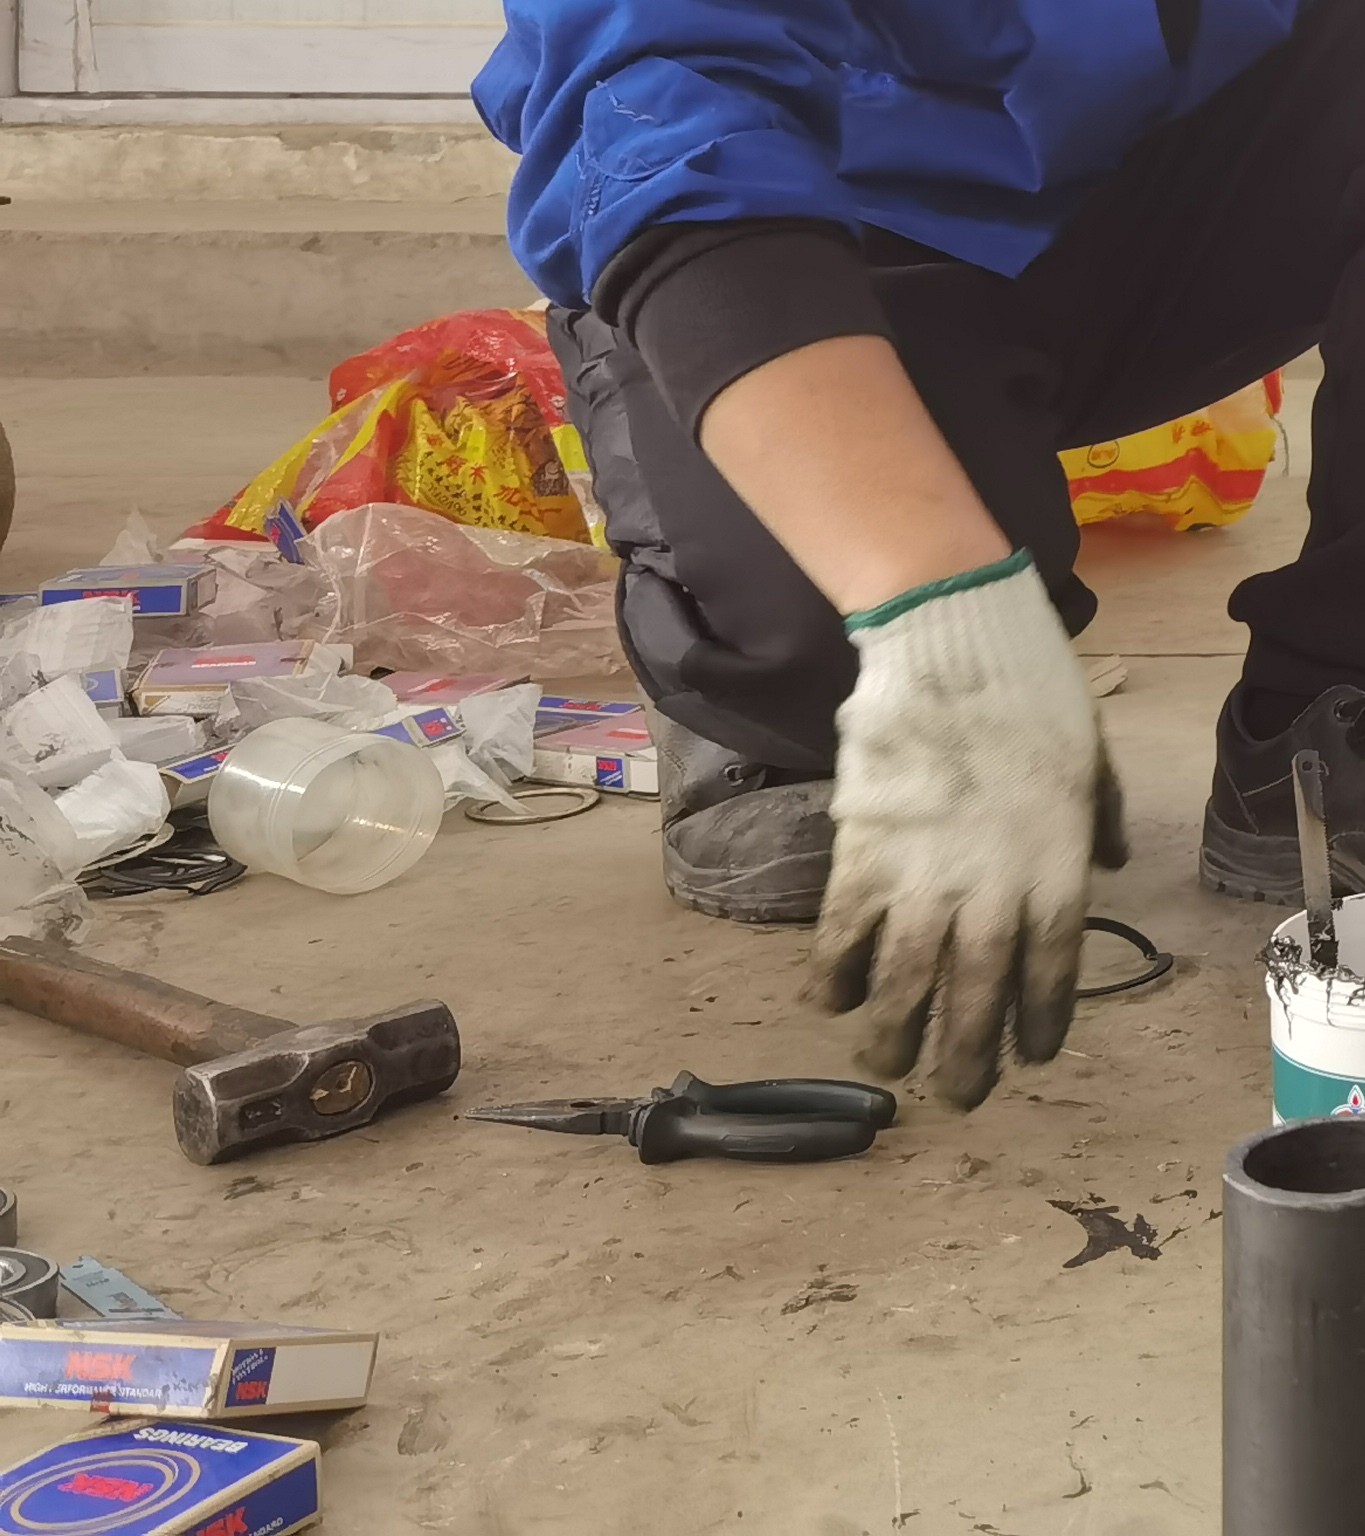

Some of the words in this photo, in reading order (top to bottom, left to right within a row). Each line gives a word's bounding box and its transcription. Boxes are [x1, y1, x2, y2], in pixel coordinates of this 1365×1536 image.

[64, 1351, 137, 1381] NSK
[236, 1381, 268, 1401] NSK
[133, 1426, 249, 1454] BEARINGS
